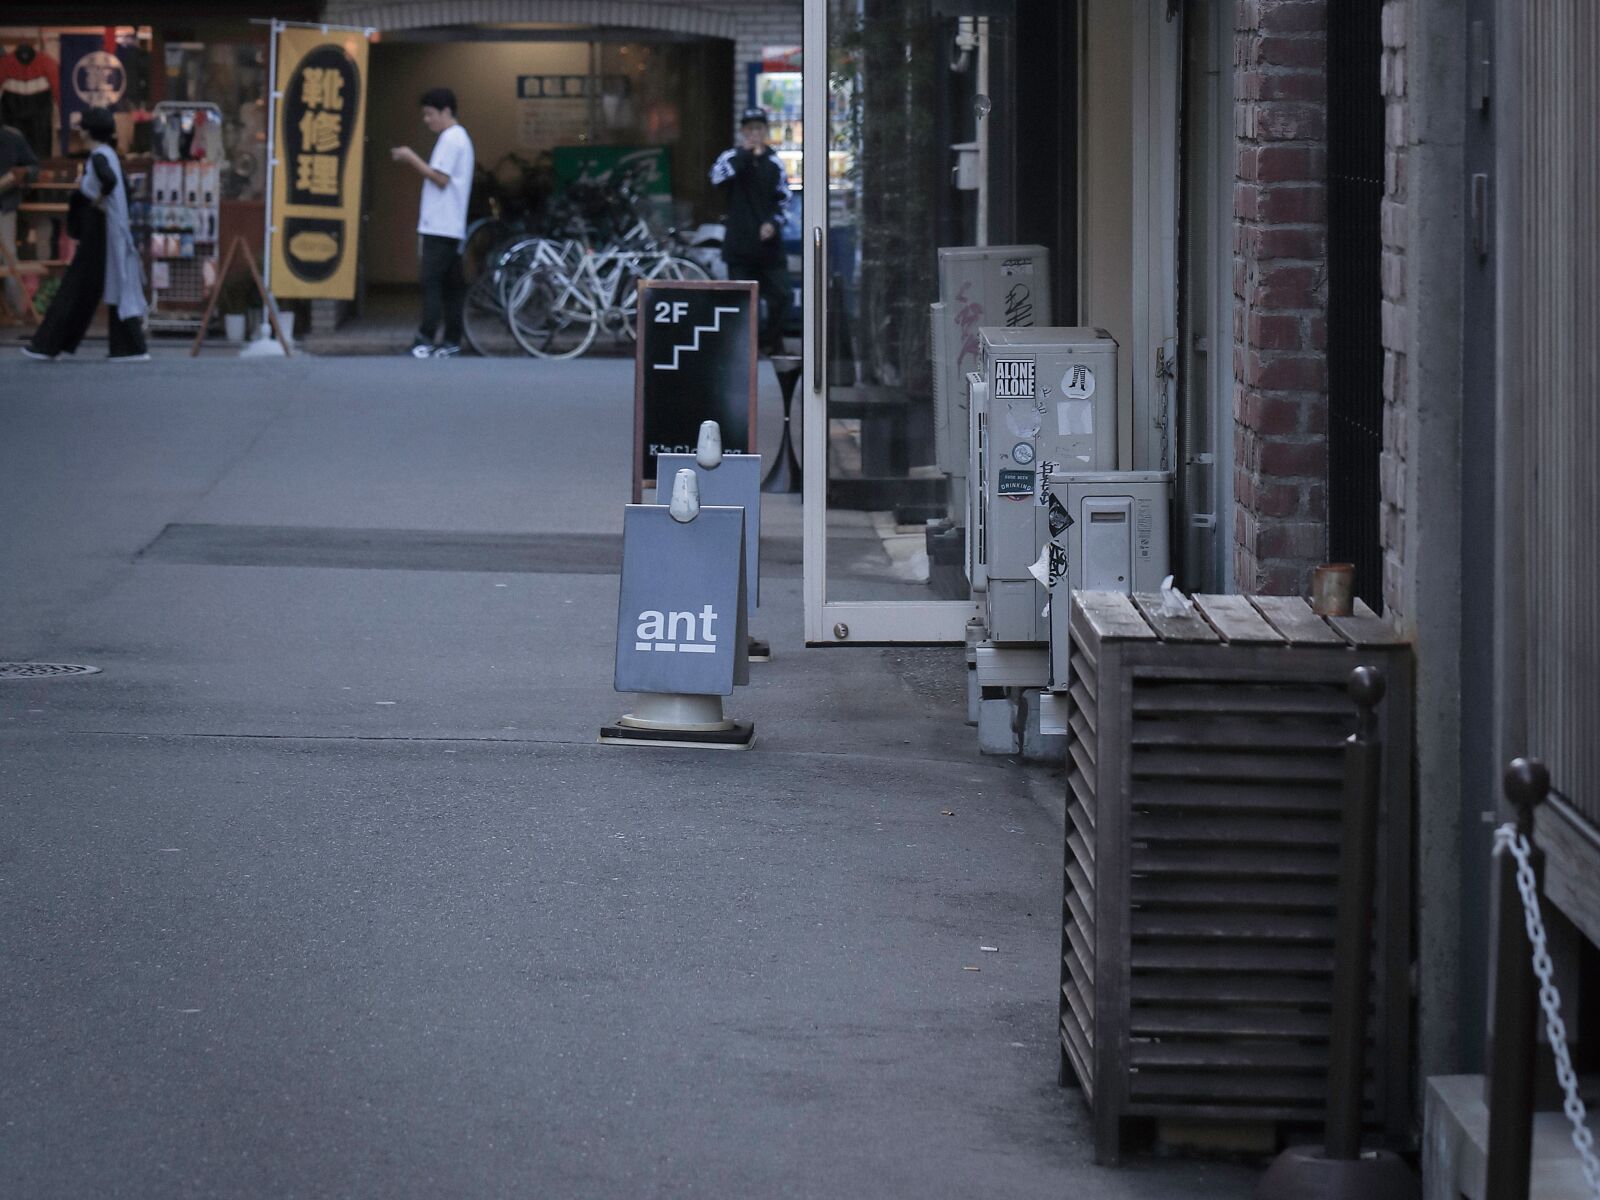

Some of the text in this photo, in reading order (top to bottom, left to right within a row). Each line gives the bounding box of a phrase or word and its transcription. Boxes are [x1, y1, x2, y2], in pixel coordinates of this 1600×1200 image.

[295, 66, 345, 195] 靴修理
[654, 302, 688, 323] 2F
[996, 362, 1035, 379] ALONE
[996, 379, 1035, 396] ALONE
[1000, 482, 1032, 491] DRINKING
[635, 603, 717, 641] ant
